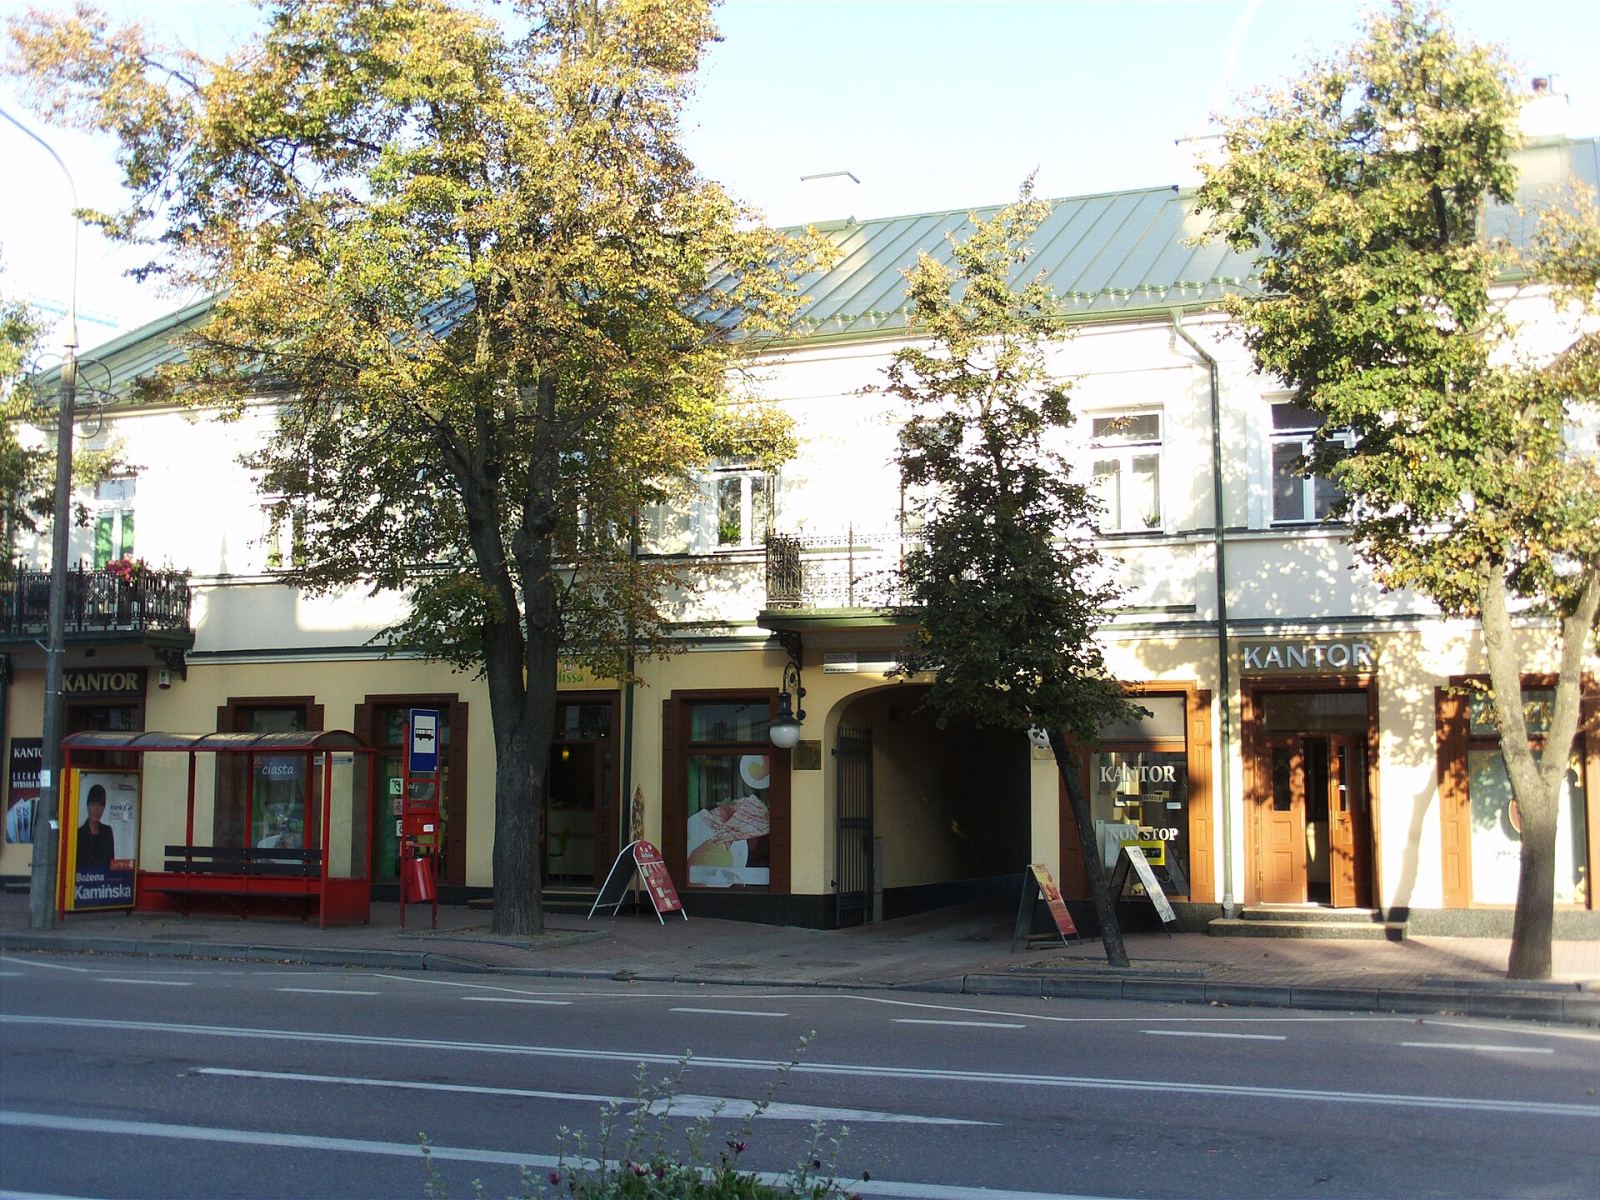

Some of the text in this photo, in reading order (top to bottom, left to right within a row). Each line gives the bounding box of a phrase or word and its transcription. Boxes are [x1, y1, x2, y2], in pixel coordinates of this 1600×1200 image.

[1244, 643, 1372, 669] KANTOR
[62, 672, 138, 691] KANTOR
[558, 670, 584, 682] lissa
[262, 763, 294, 775] ciasta
[1100, 765, 1176, 782] KANTOR
[1109, 828, 1179, 841] NON STOP
[75, 883, 132, 900] Kamińska
